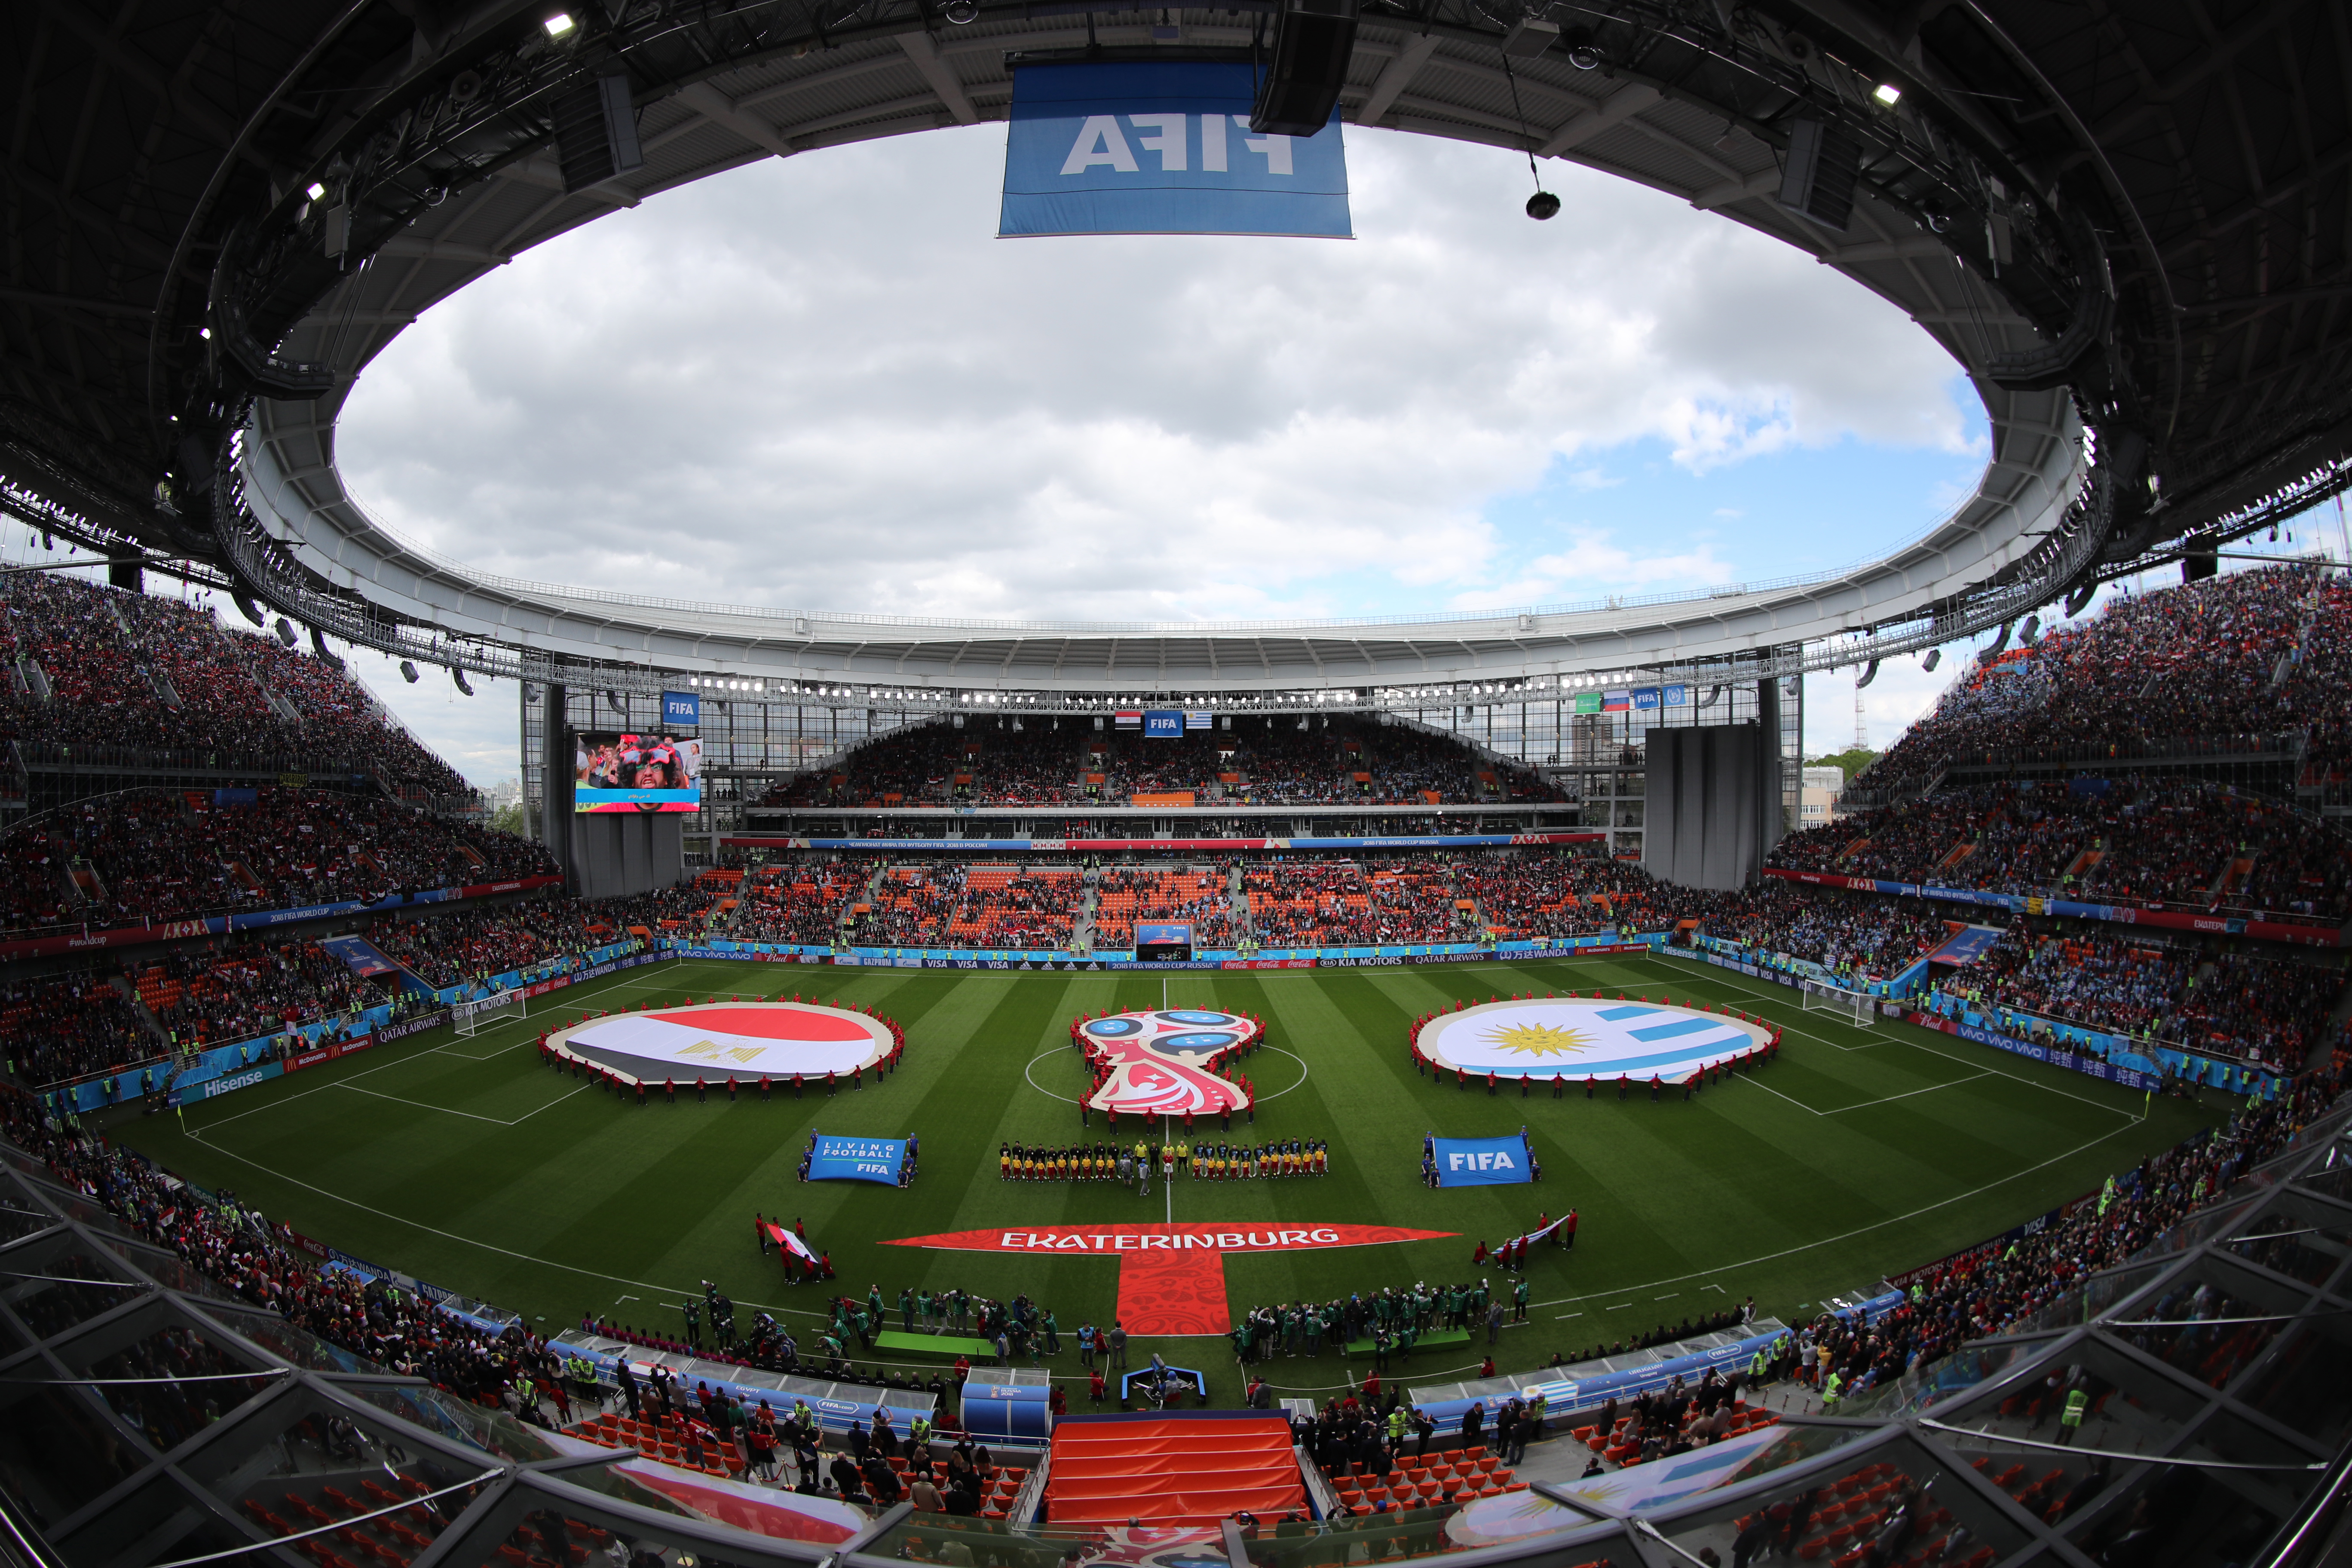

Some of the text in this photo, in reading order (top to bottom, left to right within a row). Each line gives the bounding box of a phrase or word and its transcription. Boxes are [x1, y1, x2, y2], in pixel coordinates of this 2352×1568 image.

[1637, 694, 1655, 703] FIFA
[669, 702, 694, 715] FIFA
[1151, 719, 1177, 729] FIFA
[270, 913, 285, 922] 2018
[285, 912, 297, 921] FIFA
[297, 910, 318, 919] WORLD
[318, 907, 329, 916] CUP
[764, 952, 788, 962] Bud
[1415, 953, 1484, 965] QATAR AIRWAYS
[1513, 948, 1568, 959] 万达 WANDA
[1663, 946, 1697, 959] Hisense
[864, 958, 891, 966] GAZPROM
[925, 959, 1008, 969] VISA VISA VISA
[1338, 957, 1402, 967] KIA MOTORS
[582, 962, 616, 980] 万达 WANDA
[1760, 969, 1773, 981] VISA
[1778, 974, 1792, 986] VISA
[466, 994, 511, 1017] KIA MOTORS
[1919, 1013, 1942, 1030] Bud
[380, 1015, 441, 1043] QATAR AIRWAYS
[299, 1039, 368, 1065] McDonald's McDonald's
[205, 1071, 263, 1099] Hisense
[825, 1142, 894, 1152] LIVING
[1449, 1152, 1515, 1171] FIFA
[857, 1163, 888, 1175] FIFA
[2024, 1215, 2046, 1237] VISA
[1001, 1228, 1339, 1249] EKATERINBURG
[357, 1262, 390, 1282] WANDA
[1893, 1275, 1908, 1288] KIA
[1909, 1261, 1944, 1282] MOTORS
[1711, 1347, 1739, 1357] FIFA.com
[1629, 1363, 1663, 1375] URUGUAY
[735, 1385, 760, 1393] EGYPT
[821, 1401, 853, 1410] FIFA.com
